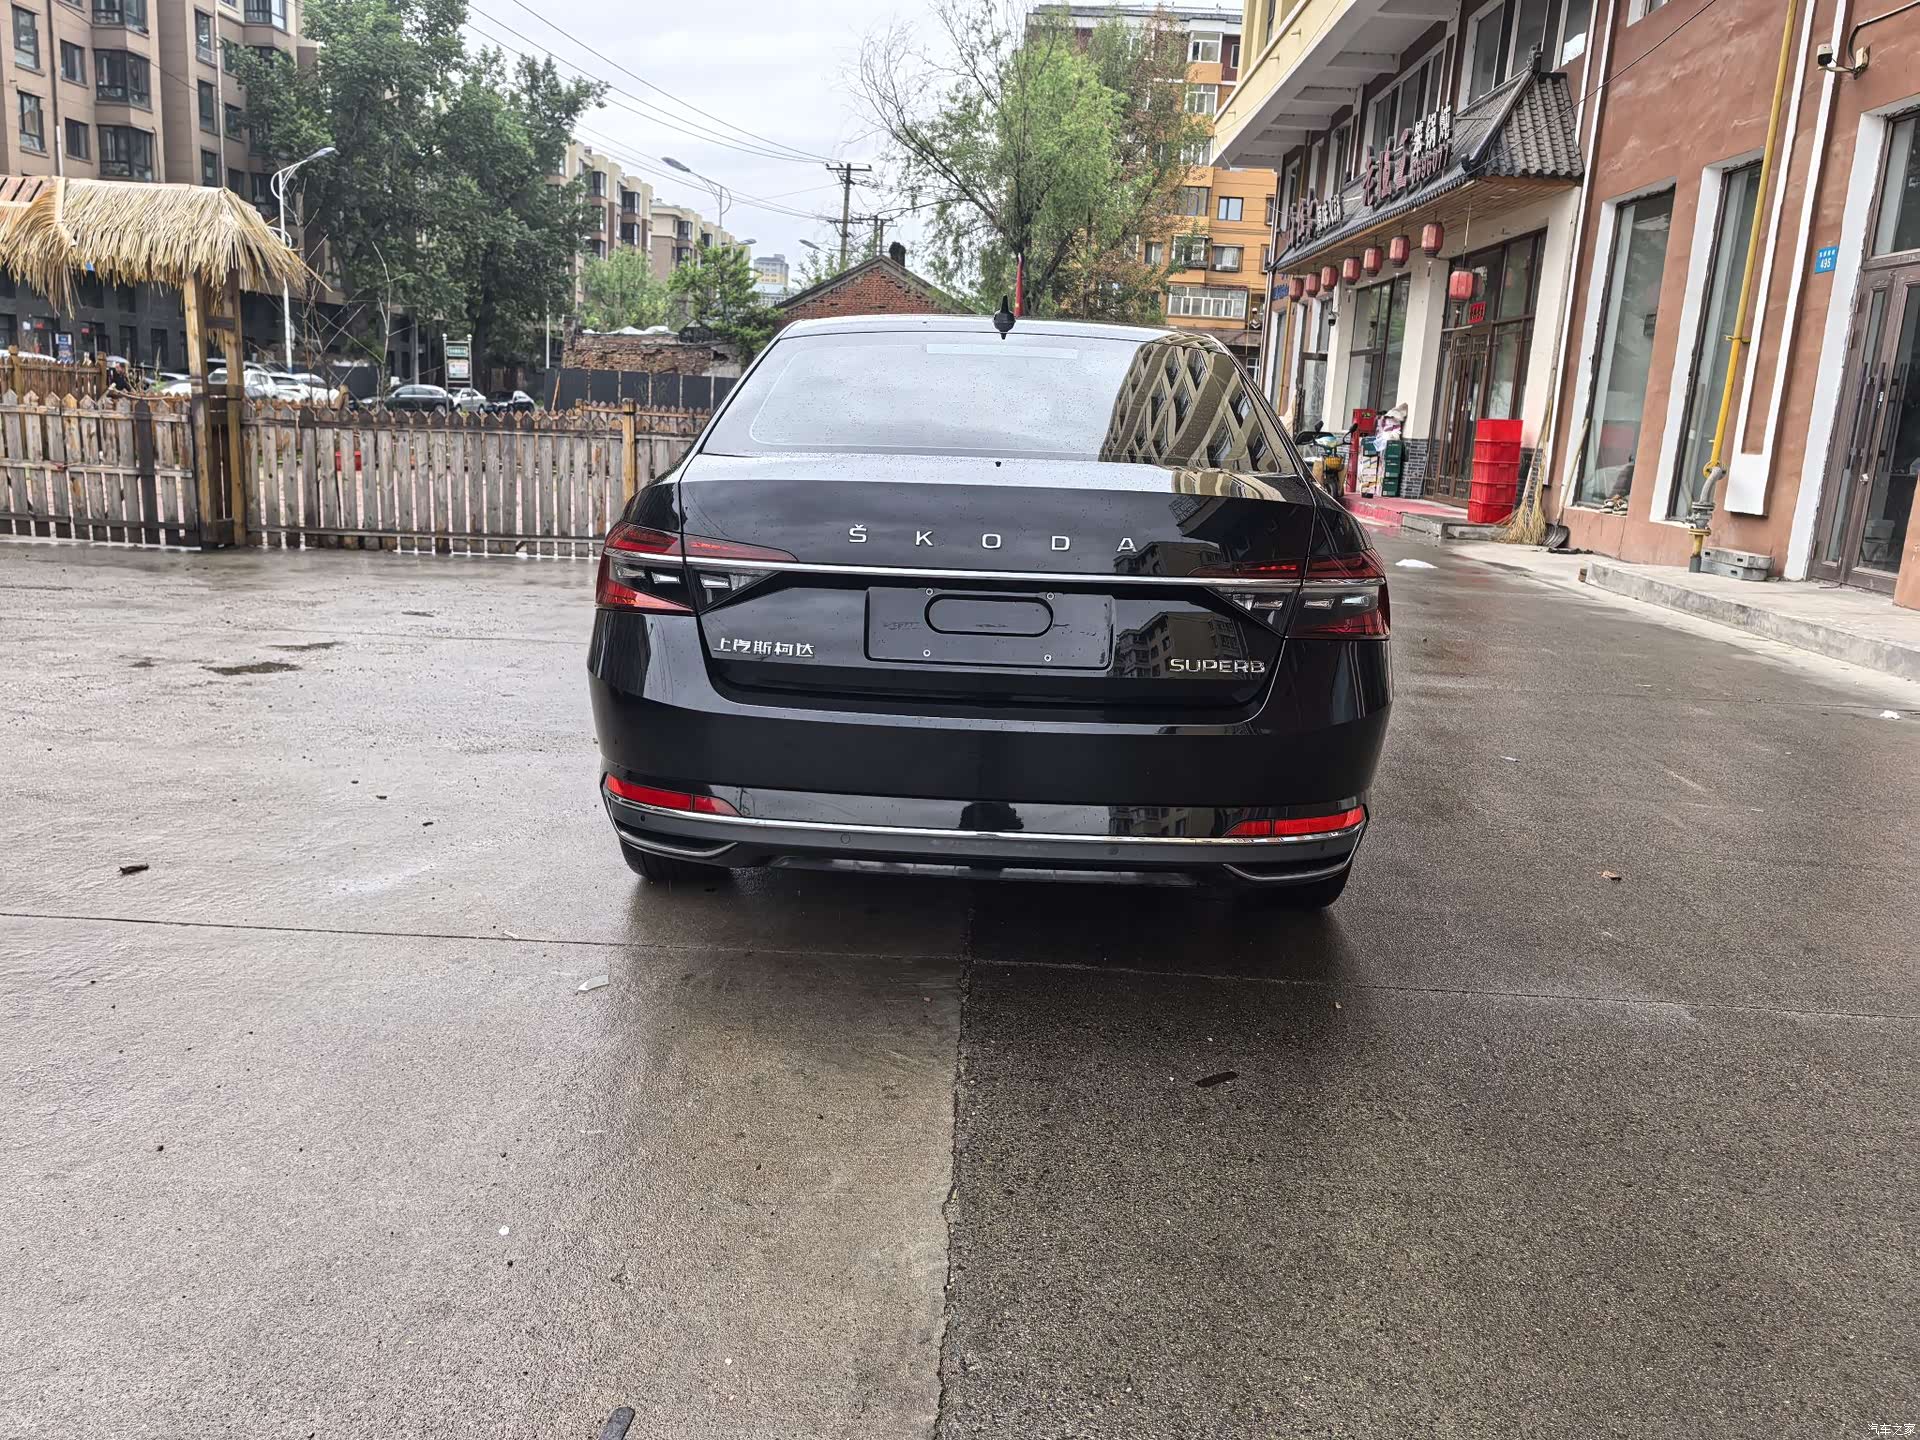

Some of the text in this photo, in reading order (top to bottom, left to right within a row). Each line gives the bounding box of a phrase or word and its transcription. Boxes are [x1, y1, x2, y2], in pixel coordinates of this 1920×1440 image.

[848, 524, 1137, 552] ŠKODA
[713, 637, 815, 658] 上汽斯柯达
[1169, 658, 1266, 673] SUPERB
